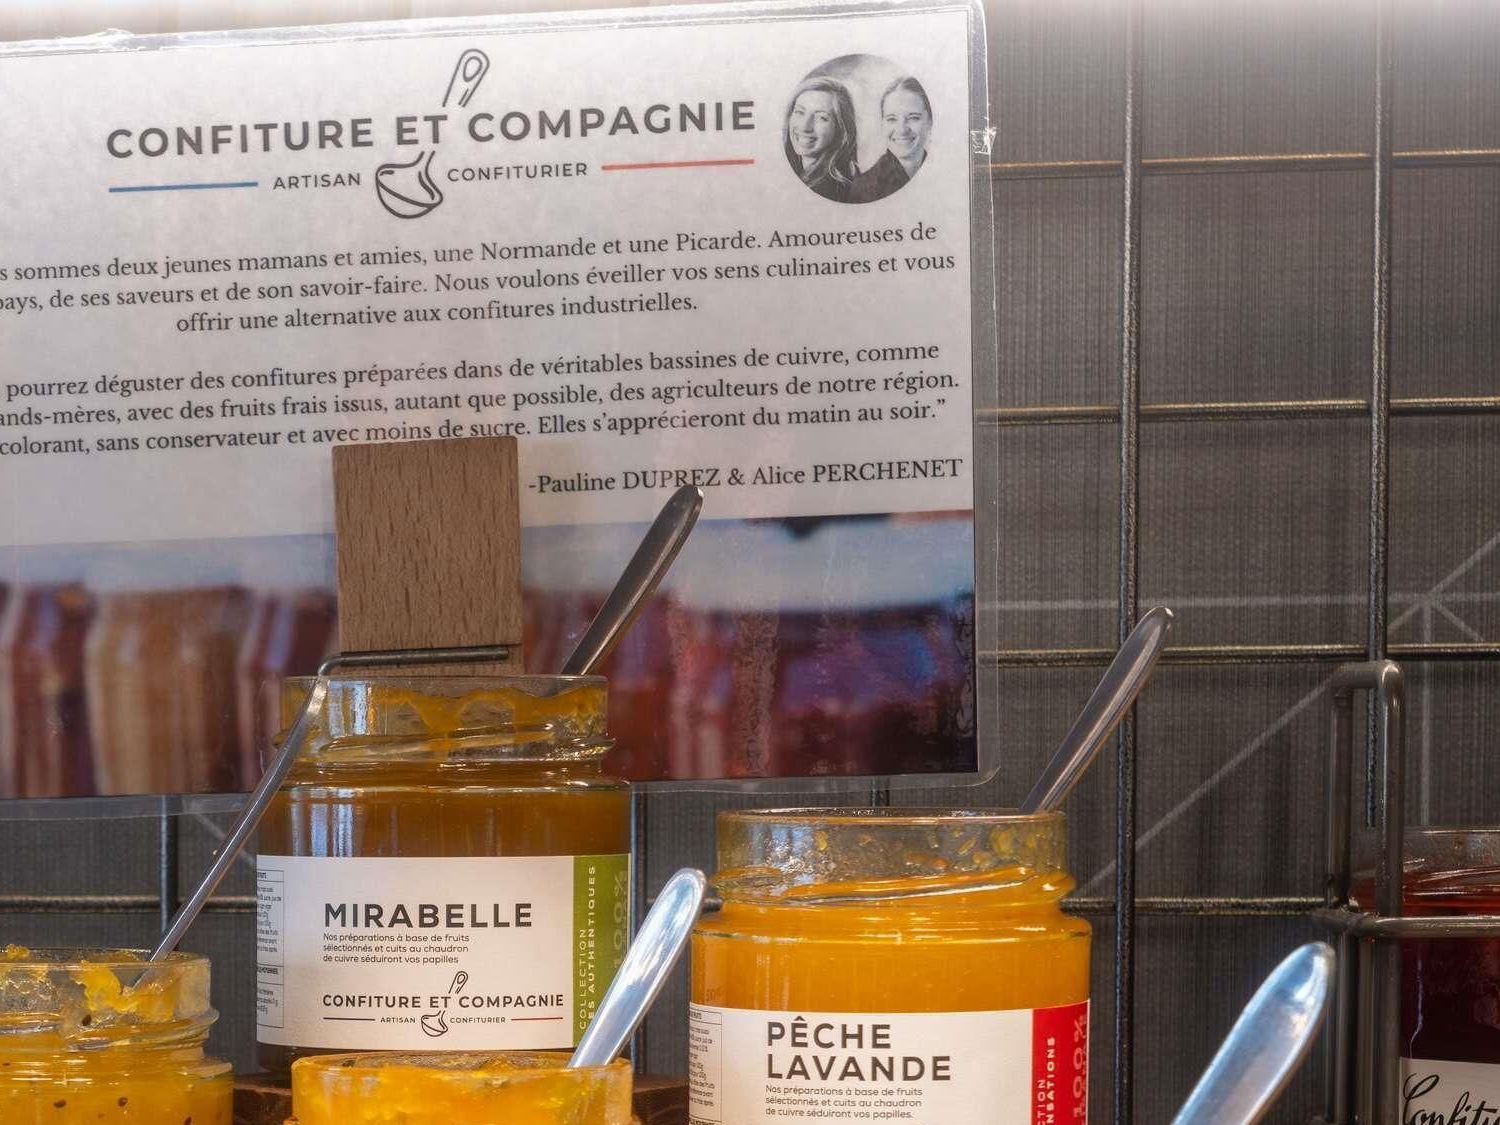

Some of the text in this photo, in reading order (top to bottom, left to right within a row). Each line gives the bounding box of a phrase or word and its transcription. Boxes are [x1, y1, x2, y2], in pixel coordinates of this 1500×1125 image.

[106, 100, 755, 158] CONFITURE ET COMPAGNIE
[272, 162, 588, 190] ARTISAN CONFITURIER
[13, 263, 101, 281] sommes
[106, 256, 159, 277] deux
[163, 255, 232, 280] jeunes
[237, 254, 329, 272] mamans
[332, 251, 354, 267] et
[359, 245, 428, 266] amies,
[433, 247, 474, 263] une
[480, 236, 597, 261] Normande
[601, 239, 623, 255] et
[628, 238, 669, 254] une
[675, 229, 762, 252] Picarde.
[766, 228, 904, 249] Amoureuses
[909, 220, 937, 241] de
[48, 288, 75, 309] de
[80, 292, 111, 308] ses
[116, 289, 196, 306] saveurs
[200, 286, 220, 303] et
[225, 281, 252, 301] de
[256, 285, 295, 300] son
[299, 274, 428, 298] savoir-faire.
[434, 273, 490, 293] Nous
[495, 268, 580, 290] voulons
[585, 263, 667, 285] éveiller
[670, 266, 709, 281] vos
[714, 264, 761, 280] sens
[765, 256, 872, 278] culinaires
[877, 256, 898, 273] et
[903, 255, 956, 272] vous
[176, 291, 698, 333] offrir une alternative aux confitures industrielles.
[5, 380, 89, 403] pourrez
[94, 374, 185, 398] déguster
[189, 370, 226, 390] des
[230, 367, 338, 389] confitures
[342, 362, 448, 389] préparées
[453, 359, 503, 380] dans
[508, 357, 535, 377] de
[540, 352, 644, 376] véritables
[648, 349, 737, 371] bassines
[743, 347, 770, 368] de
[775, 346, 850, 367] cuivre,
[855, 345, 940, 363] comme
[126, 406, 174, 422] avec
[179, 399, 215, 420] des
[219, 397, 277, 418] fruits
[281, 395, 328, 416] frais
[333, 394, 389, 415] issus,
[394, 393, 462, 411] autant
[467, 393, 507, 414] que
[512, 383, 604, 412] possible,
[609, 381, 645, 402] des
[651, 378, 779, 405] agriculteurs
[784, 375, 812, 396] de
[817, 377, 877, 395] notre
[882, 369, 960, 396] région.
[96, 437, 140, 452] sans
[145, 431, 282, 450] conservateur
[286, 428, 307, 445] et
[312, 427, 360, 443] avec
[365, 420, 433, 441] moins
[437, 418, 464, 439] de
[469, 421, 531, 438] sucre.
[537, 413, 587, 435] Elles
[592, 409, 747, 436] s’apprécieront
[752, 406, 781, 426] du
[787, 403, 852, 425] matin
[857, 407, 884, 422] au
[889, 397, 946, 421] soir.”
[528, 458, 964, 494] -Pauline DUPREZ & Alice PERCHENET
[324, 903, 532, 928] MIRABELLE
[323, 994, 564, 1008] CONFITURE ET COMPAGNIE
[450, 1016, 506, 1024] CONFITURIER
[768, 1016, 891, 1049] PÊCHE
[767, 1054, 951, 1082] LAVANDE
